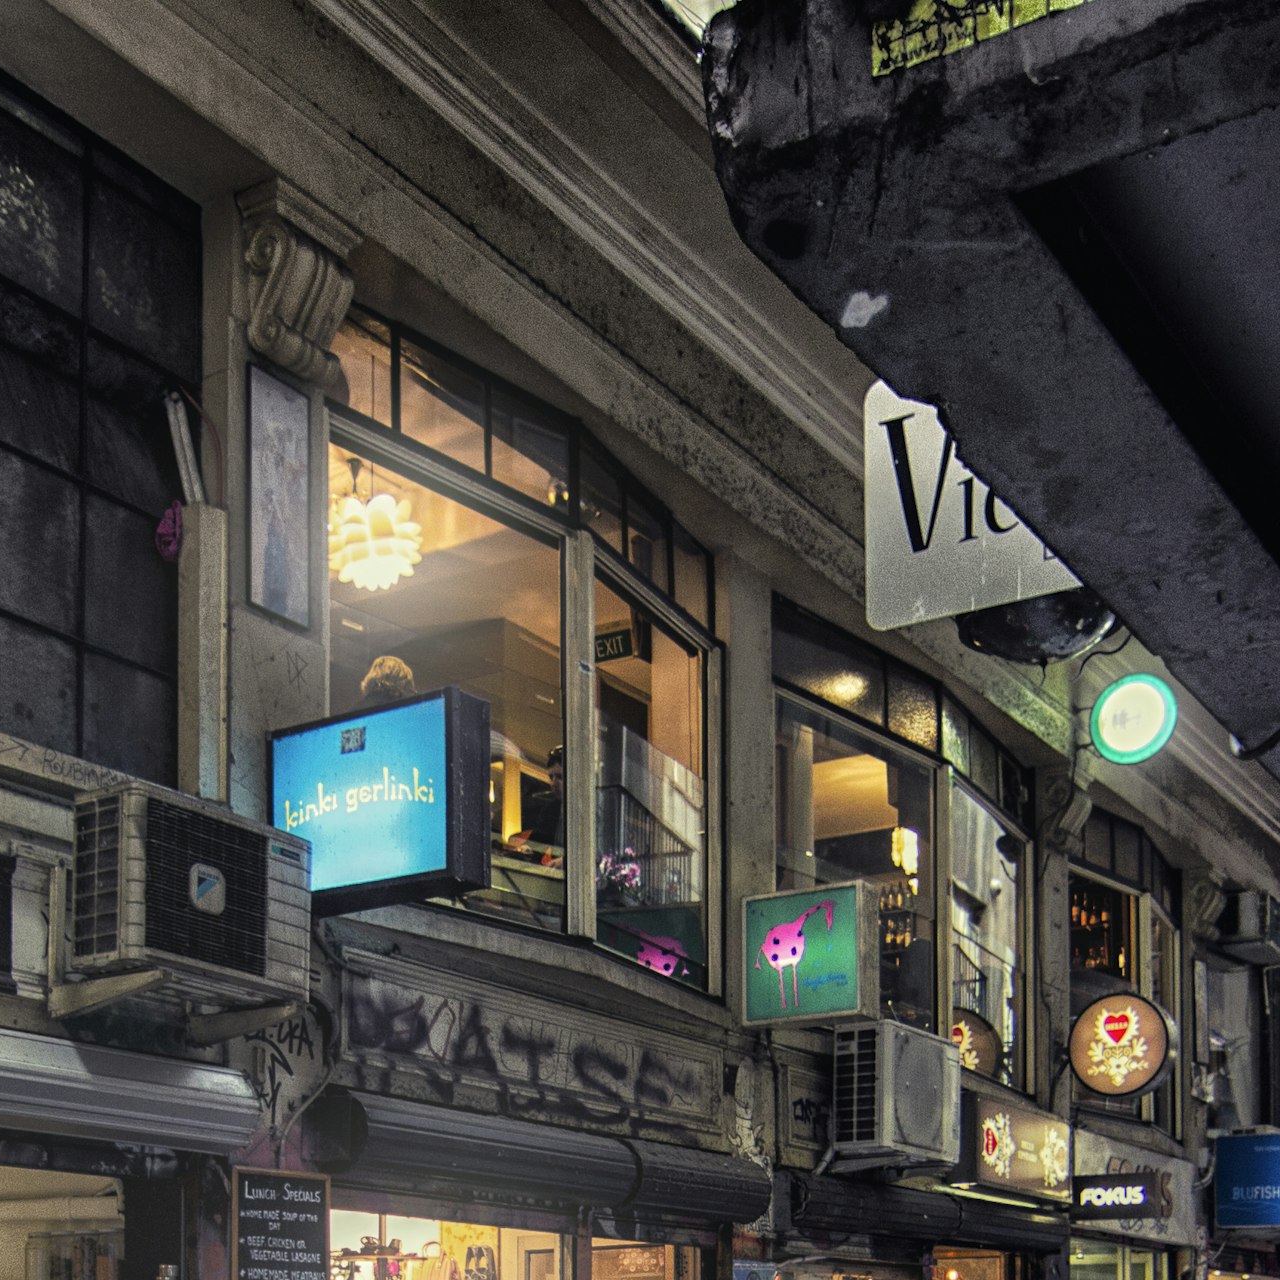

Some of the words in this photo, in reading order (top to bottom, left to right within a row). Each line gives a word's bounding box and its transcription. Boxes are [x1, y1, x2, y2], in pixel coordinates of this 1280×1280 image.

[595, 635, 623, 658] EXIT
[286, 783, 338, 831] kinki
[346, 767, 434, 813] gerlinki
[1080, 1185, 1144, 1206] FOKUS
[282, 1212, 298, 1222] SOUP
[269, 1221, 281, 1231] DAY
[268, 1237, 295, 1250] CHICKEN
[297, 1241, 306, 1249] OR
[250, 1250, 289, 1262] VEGETABLE
[291, 1251, 321, 1264] LASAGNE
